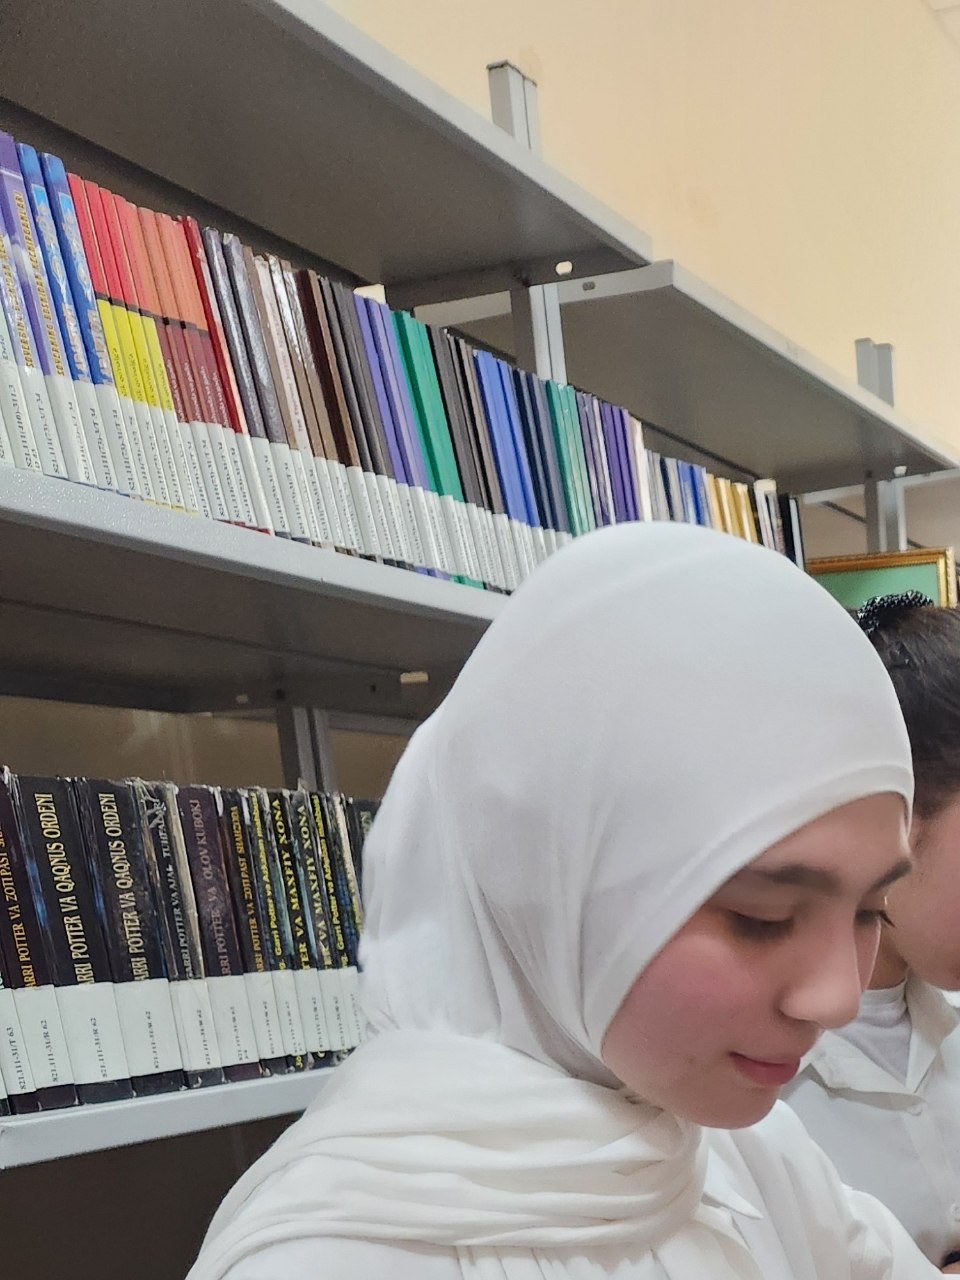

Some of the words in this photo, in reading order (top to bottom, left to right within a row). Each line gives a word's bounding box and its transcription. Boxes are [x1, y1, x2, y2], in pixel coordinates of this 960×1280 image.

[35, 793, 62, 838] ORDENI
[99, 793, 123, 837] ORDENI
[189, 799, 207, 846] KUBOKI
[271, 800, 288, 845] XONA
[297, 805, 312, 850] XONA
[47, 842, 75, 893] QAQNUS
[108, 840, 134, 889] QAQNUS
[198, 848, 213, 880] OLOV
[282, 850, 300, 911] MAXFIY
[119, 891, 136, 909] VA
[306, 855, 323, 915] MAXFIY
[8, 904, 21, 920] VA
[59, 895, 79, 913] VA
[246, 902, 255, 916] VA
[267, 899, 277, 929] Potter
[330, 895, 339, 926] Potter
[13, 922, 31, 962] POTTER
[63, 915, 90, 960] POTTER
[123, 911, 144, 954] POTTER
[173, 908, 188, 947] POTTER
[210, 909, 230, 953] POTTER
[248, 918, 261, 952] POTTER
[294, 916, 304, 937] VA
[317, 920, 327, 941] VA
[74, 962, 95, 985] RRI
[131, 957, 149, 981] ARRI
[218, 951, 231, 977] RRI
[299, 942, 310, 970] TER
[22, 963, 38, 988] ARRI
[10, 1039, 27, 1090] 821.111-31/T
